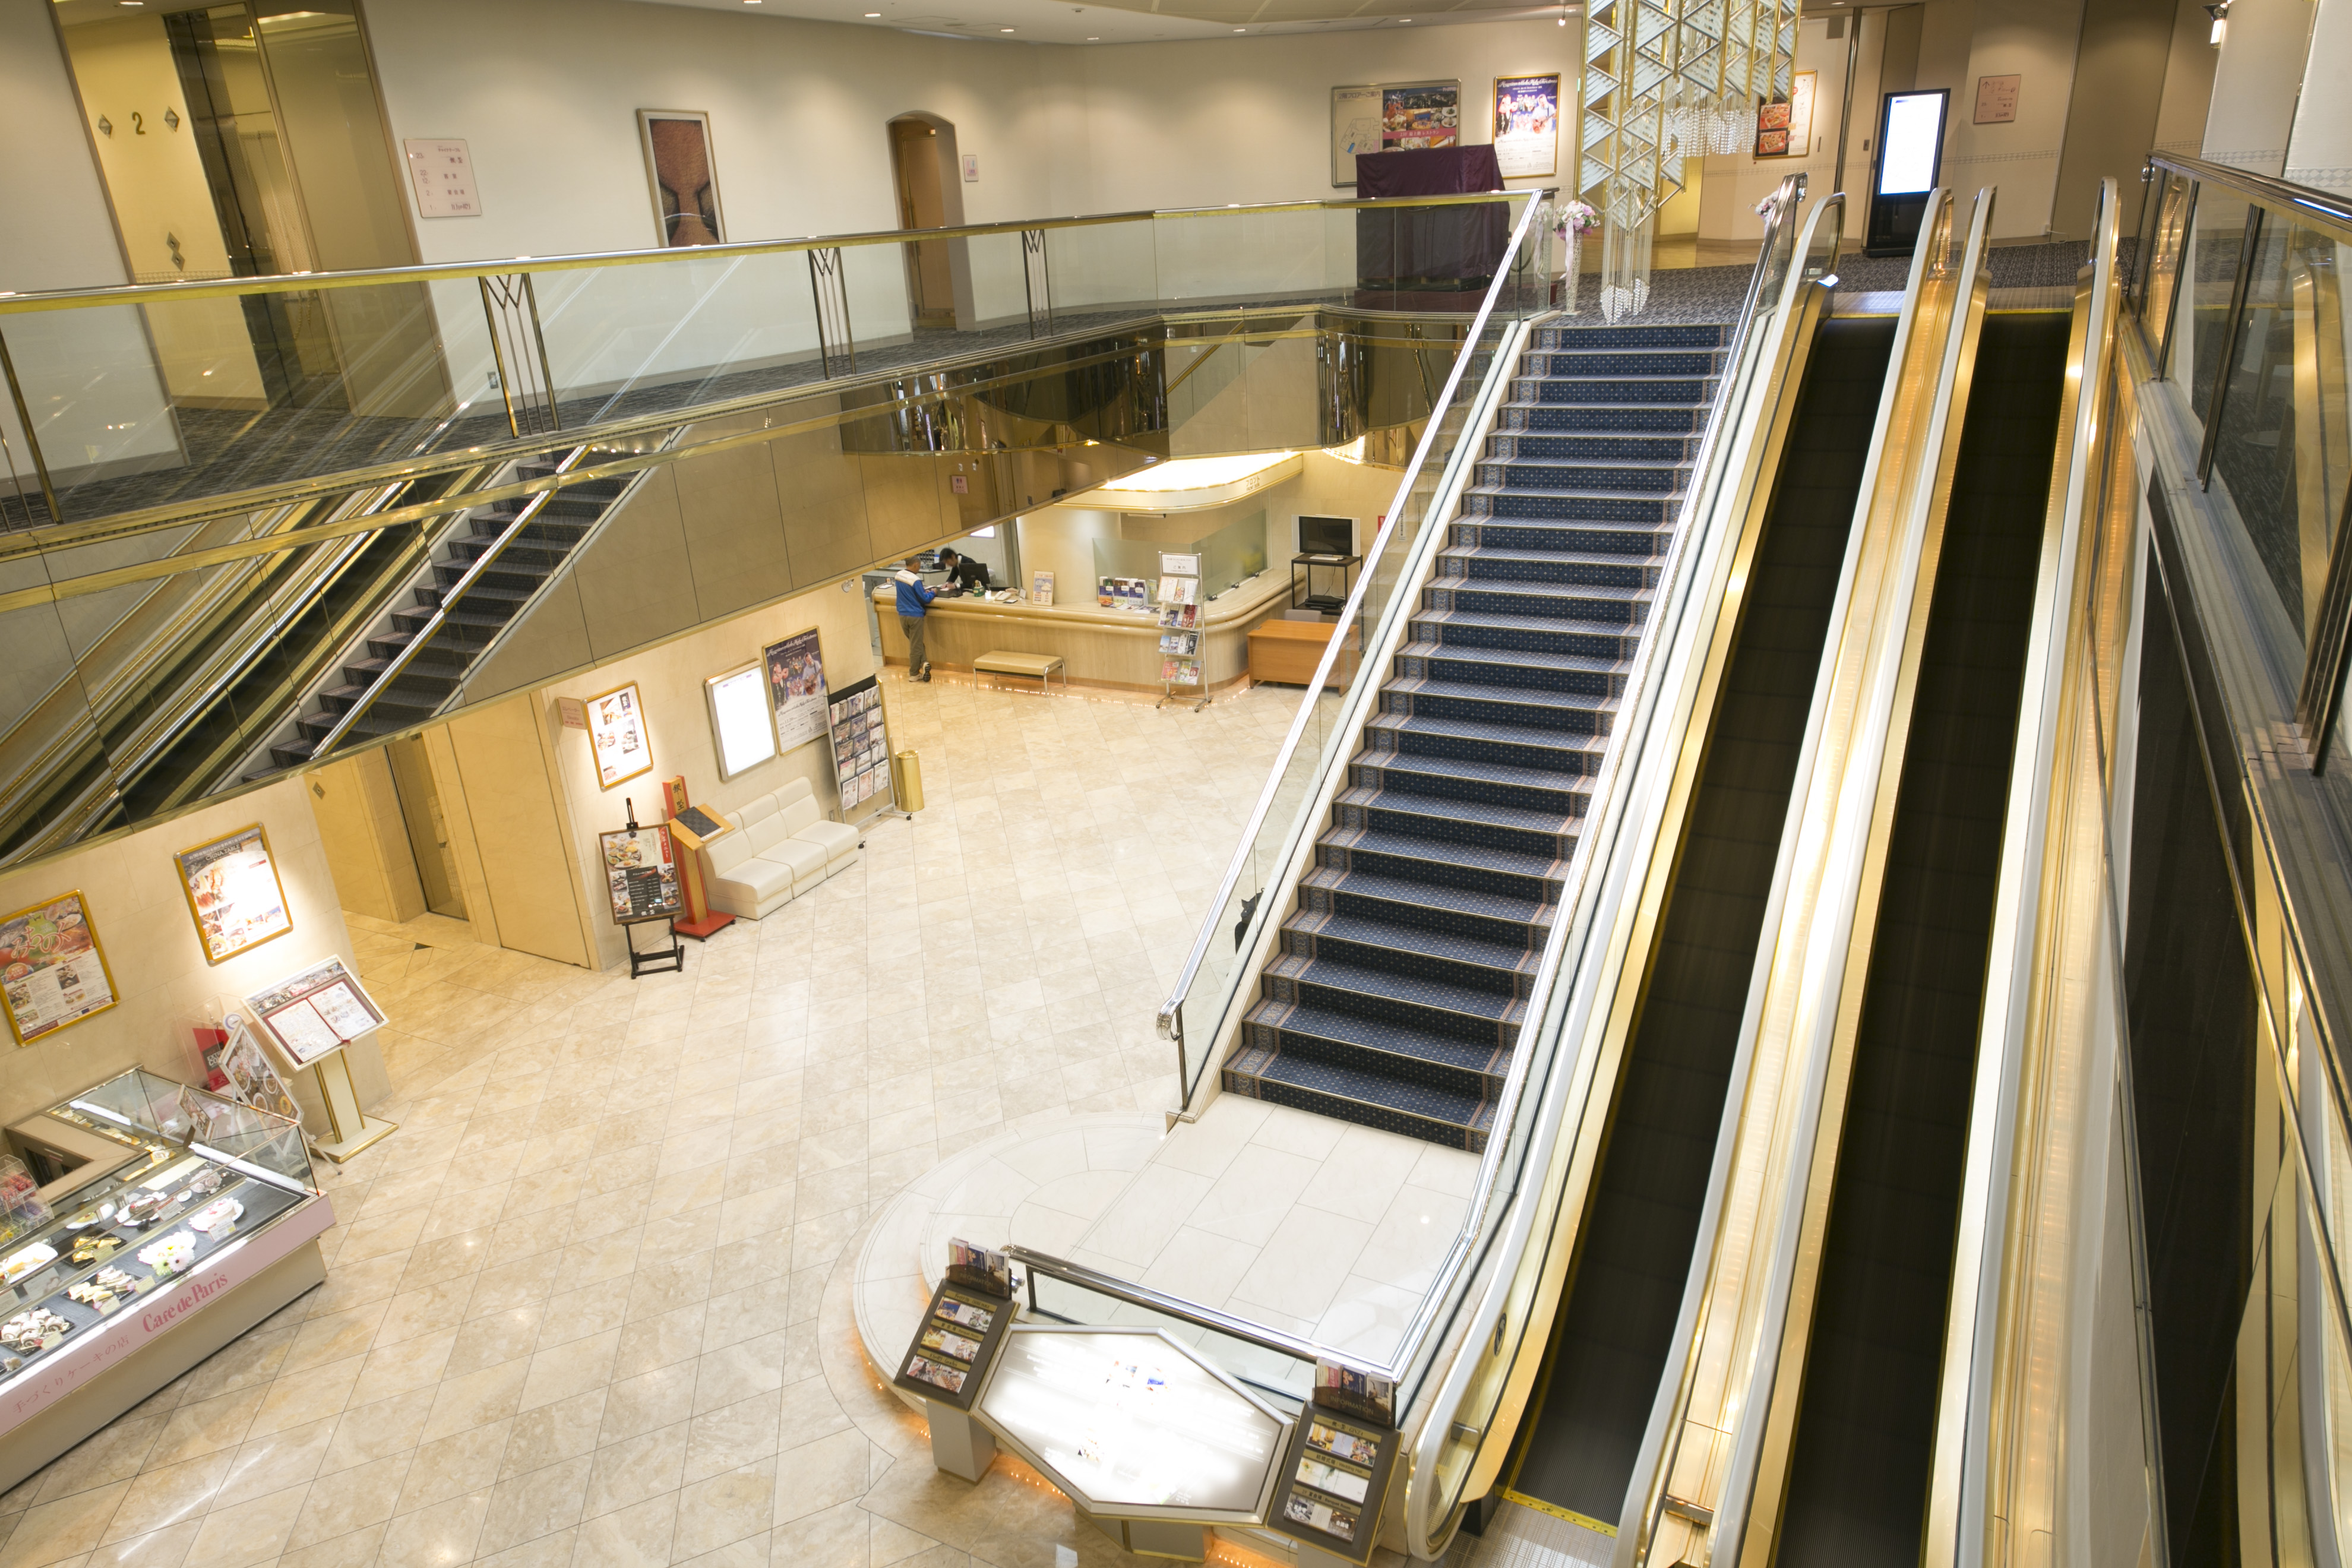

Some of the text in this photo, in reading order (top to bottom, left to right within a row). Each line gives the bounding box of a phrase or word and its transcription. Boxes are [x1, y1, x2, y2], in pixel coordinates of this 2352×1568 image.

[1339, 90, 1380, 99] 2階フロアーご案内
[132, 111, 146, 135] 2
[1246, 475, 1260, 486] フロント
[206, 843, 240, 861] CHINA TABLE
[11, 921, 72, 959] みちのく
[207, 1049, 222, 1061] EXTR
[960, 1273, 993, 1288] INFORMATION
[143, 1304, 176, 1332] Café
[177, 1296, 194, 1313] de
[191, 1273, 227, 1304] Paris
[12, 1335, 129, 1414] 手づくりケーキの店
[1330, 1395, 1374, 1414] INFORMATION
[1339, 1462, 1354, 1472] Wedding
[1324, 1497, 1339, 1507] Banquet
